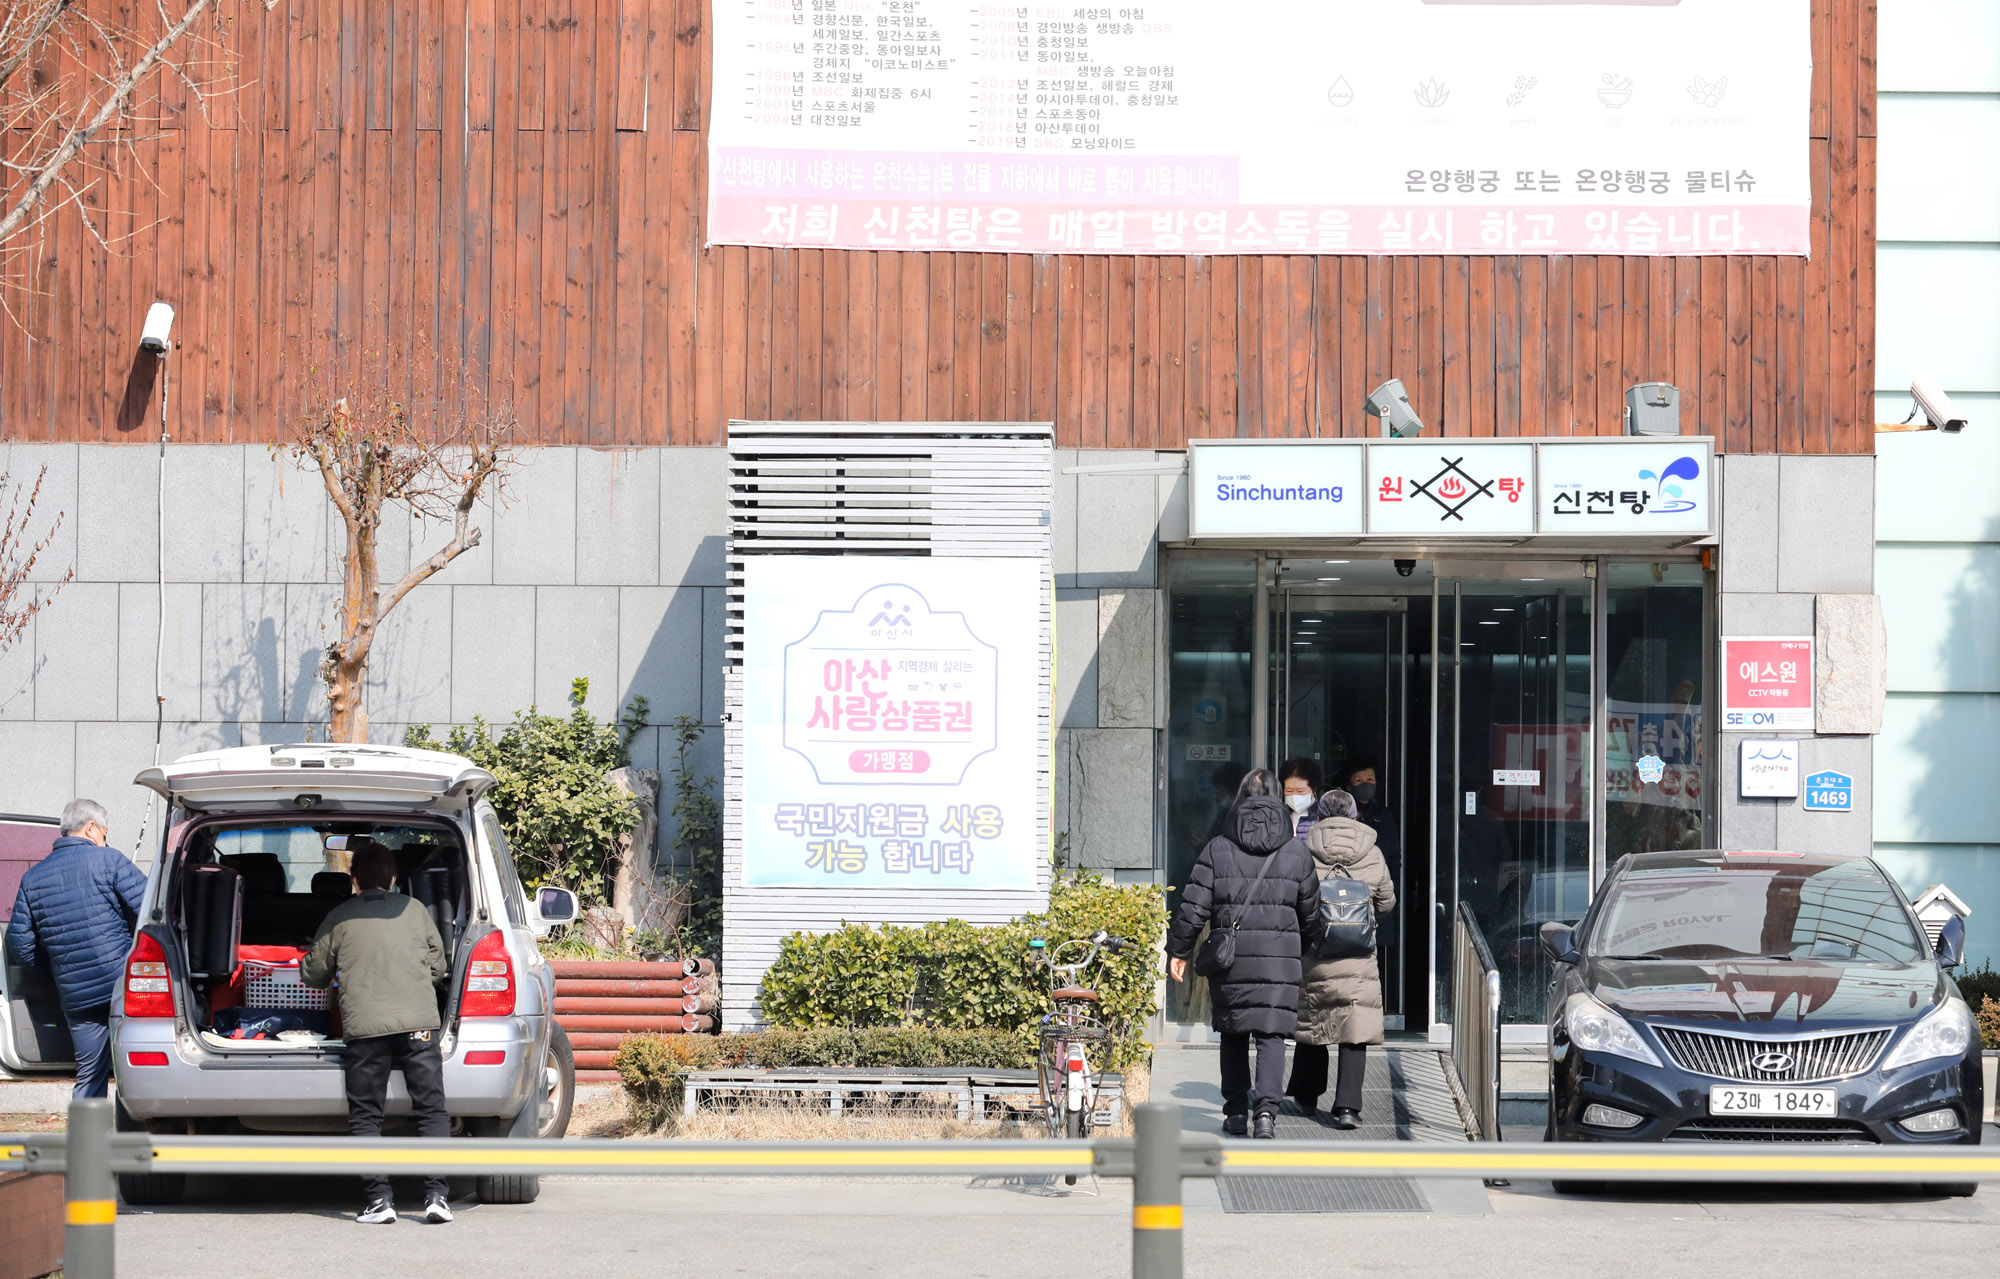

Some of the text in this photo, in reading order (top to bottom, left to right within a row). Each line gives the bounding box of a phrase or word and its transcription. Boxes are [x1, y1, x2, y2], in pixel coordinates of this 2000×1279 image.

[1036, 8, 1065, 19] KBS
[1073, 8, 1111, 20] 세상의
[1119, 8, 1143, 20] 아침
[812, 14, 868, 26] 경향신문,
[876, 16, 932, 28] 한국일보,
[812, 28, 941, 41] 세계일보, 일간스포츠
[1037, 22, 1088, 34] 경인방송
[1096, 23, 1134, 34] 생방송
[1142, 23, 1173, 33] OBS
[1036, 36, 1088, 48] 충청일보
[812, 43, 868, 55] 주간중앙,
[876, 44, 941, 56] 동아일보사
[813, 57, 850, 69] 경제지
[1037, 51, 1093, 63] 동아일보,
[812, 72, 863, 83] 조선일보
[1036, 65, 1174, 77] MBC 생방송 오늘아침
[811, 86, 844, 97] MBC
[851, 87, 903, 99] 화제집중
[910, 88, 931, 99] 6시
[1036, 80, 1093, 91] 조선일보,
[1101, 80, 1140, 92] 헤럴드
[1148, 80, 1172, 92] 경제
[1036, 94, 1118, 106] 아시아투데이,
[1127, 94, 1178, 106] 충청일보
[811, 101, 876, 113] 스포츠서울
[811, 114, 861, 127] 대전일보
[1035, 109, 1100, 120] 스포츠동아
[1035, 123, 1099, 135] 아산투데이
[1035, 138, 1064, 149] SBS
[1070, 138, 1136, 150] 모닝와이드
[805, 159, 864, 191] 사용하는
[963, 163, 992, 193] 건물
[1000, 164, 1059, 195] 지하에서
[1067, 165, 1096, 194] 바로
[1105, 165, 1135, 194] 뽑아
[1404, 168, 1757, 195] 온양행궁 또는 온양행궁 물티슈
[761, 203, 1760, 251] 저희 신천탕은 매일 방역소독을 실시 하고 있습니다.
[1217, 484, 1343, 503] Sinchuntang
[1379, 476, 1525, 504] 원 탕
[1553, 490, 1651, 515] 신천탕
[871, 628, 913, 641] 아산시
[897, 660, 974, 674] 지역경제 살리는
[1739, 661, 1797, 684] 에스원
[823, 658, 893, 699] 아산
[1748, 688, 1768, 697] CCTV
[806, 694, 973, 733] 사랑상품권
[1726, 712, 1775, 725] SECOM
[863, 751, 914, 771] 가맹점
[1811, 790, 1848, 806] 1469
[774, 802, 1004, 840] 국민지원금 사용
[805, 839, 974, 875] 가능 합니다
[1723, 1091, 1824, 1111] 23마 1849
